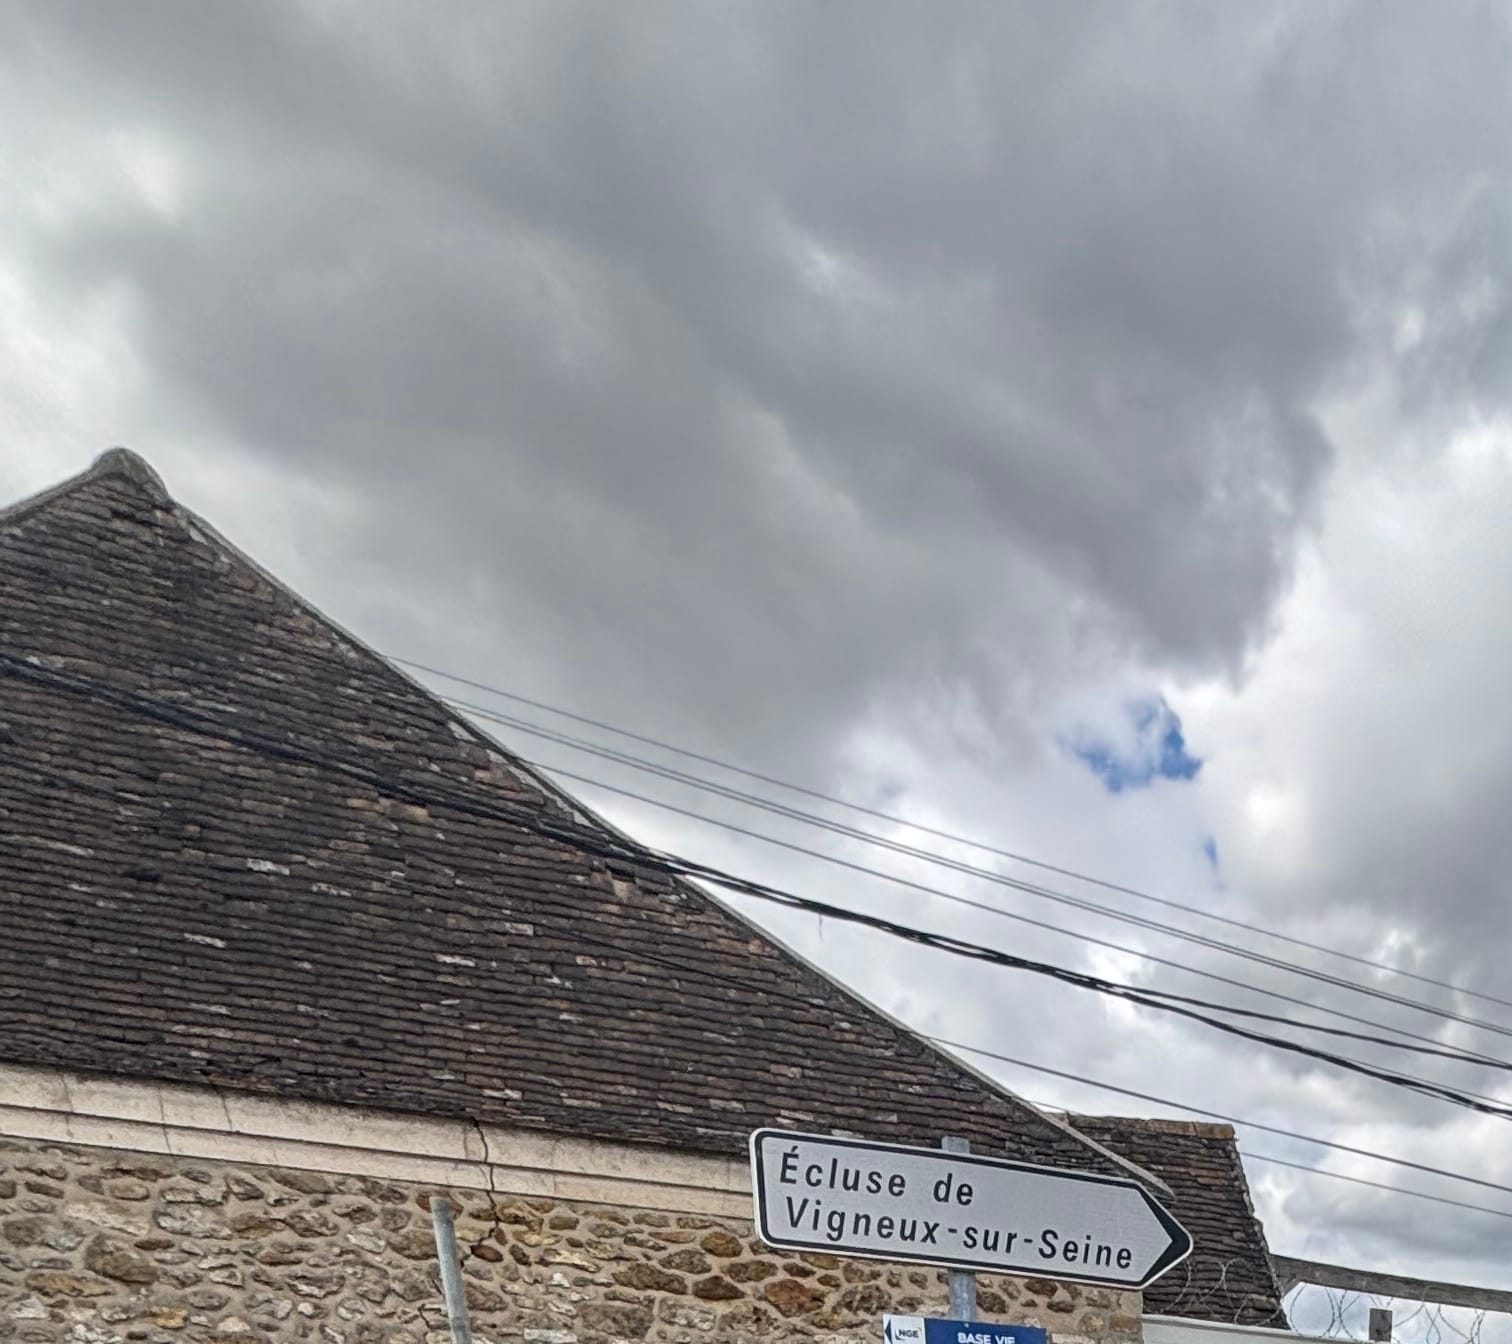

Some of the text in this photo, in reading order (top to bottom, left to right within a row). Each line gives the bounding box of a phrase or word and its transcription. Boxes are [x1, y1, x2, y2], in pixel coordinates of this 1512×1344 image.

[779, 1146, 974, 1206] Écluse de
[785, 1196, 1133, 1270] Vigneux-sur-Seine
